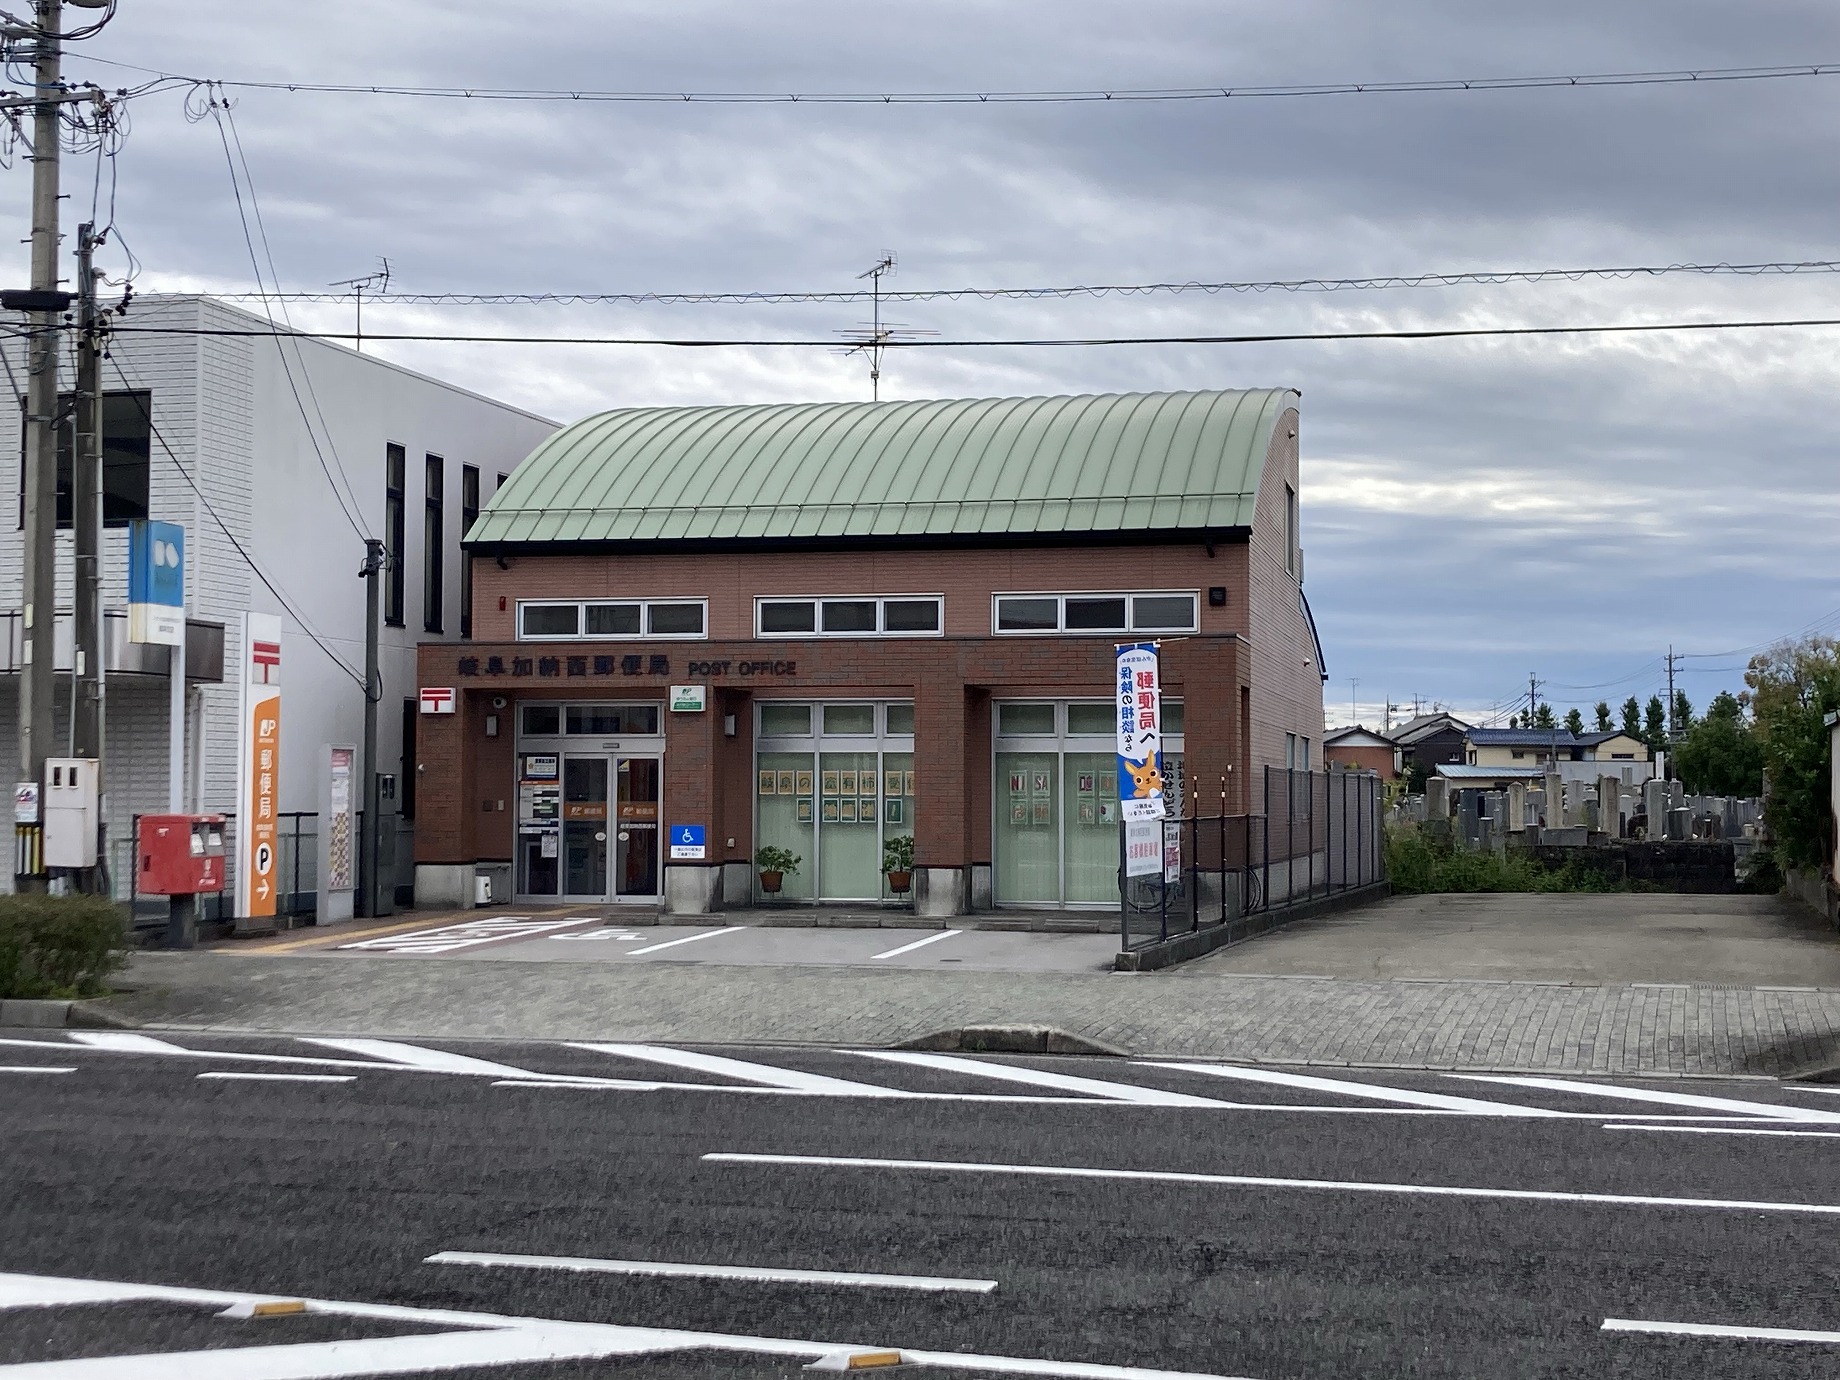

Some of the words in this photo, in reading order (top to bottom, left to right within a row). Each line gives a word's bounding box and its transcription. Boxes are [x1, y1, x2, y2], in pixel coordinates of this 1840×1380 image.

[688, 661, 731, 676] POST
[738, 661, 796, 676] OFFICE
[260, 848, 269, 870] P
